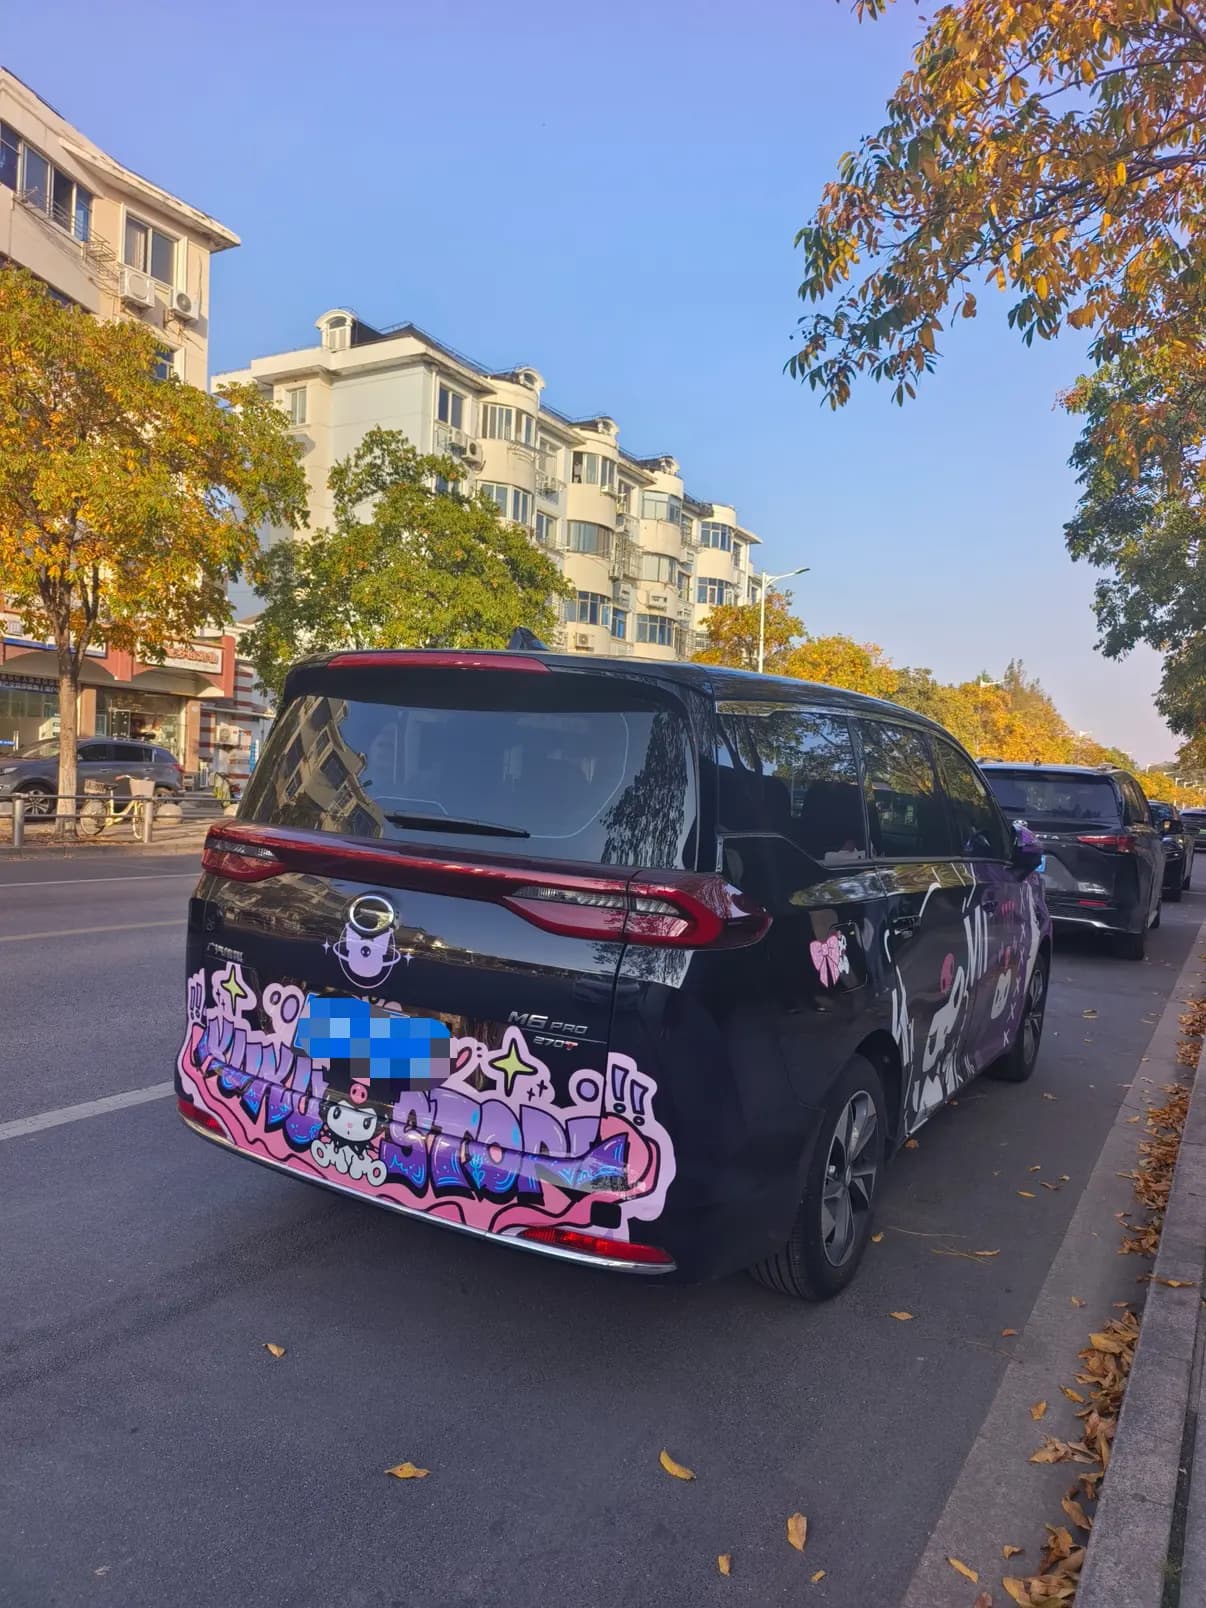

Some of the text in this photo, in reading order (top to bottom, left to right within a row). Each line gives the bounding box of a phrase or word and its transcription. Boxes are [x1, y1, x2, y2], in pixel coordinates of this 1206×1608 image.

[508, 1011, 588, 1034] M6 PRO
[534, 1036, 578, 1051] 270T
